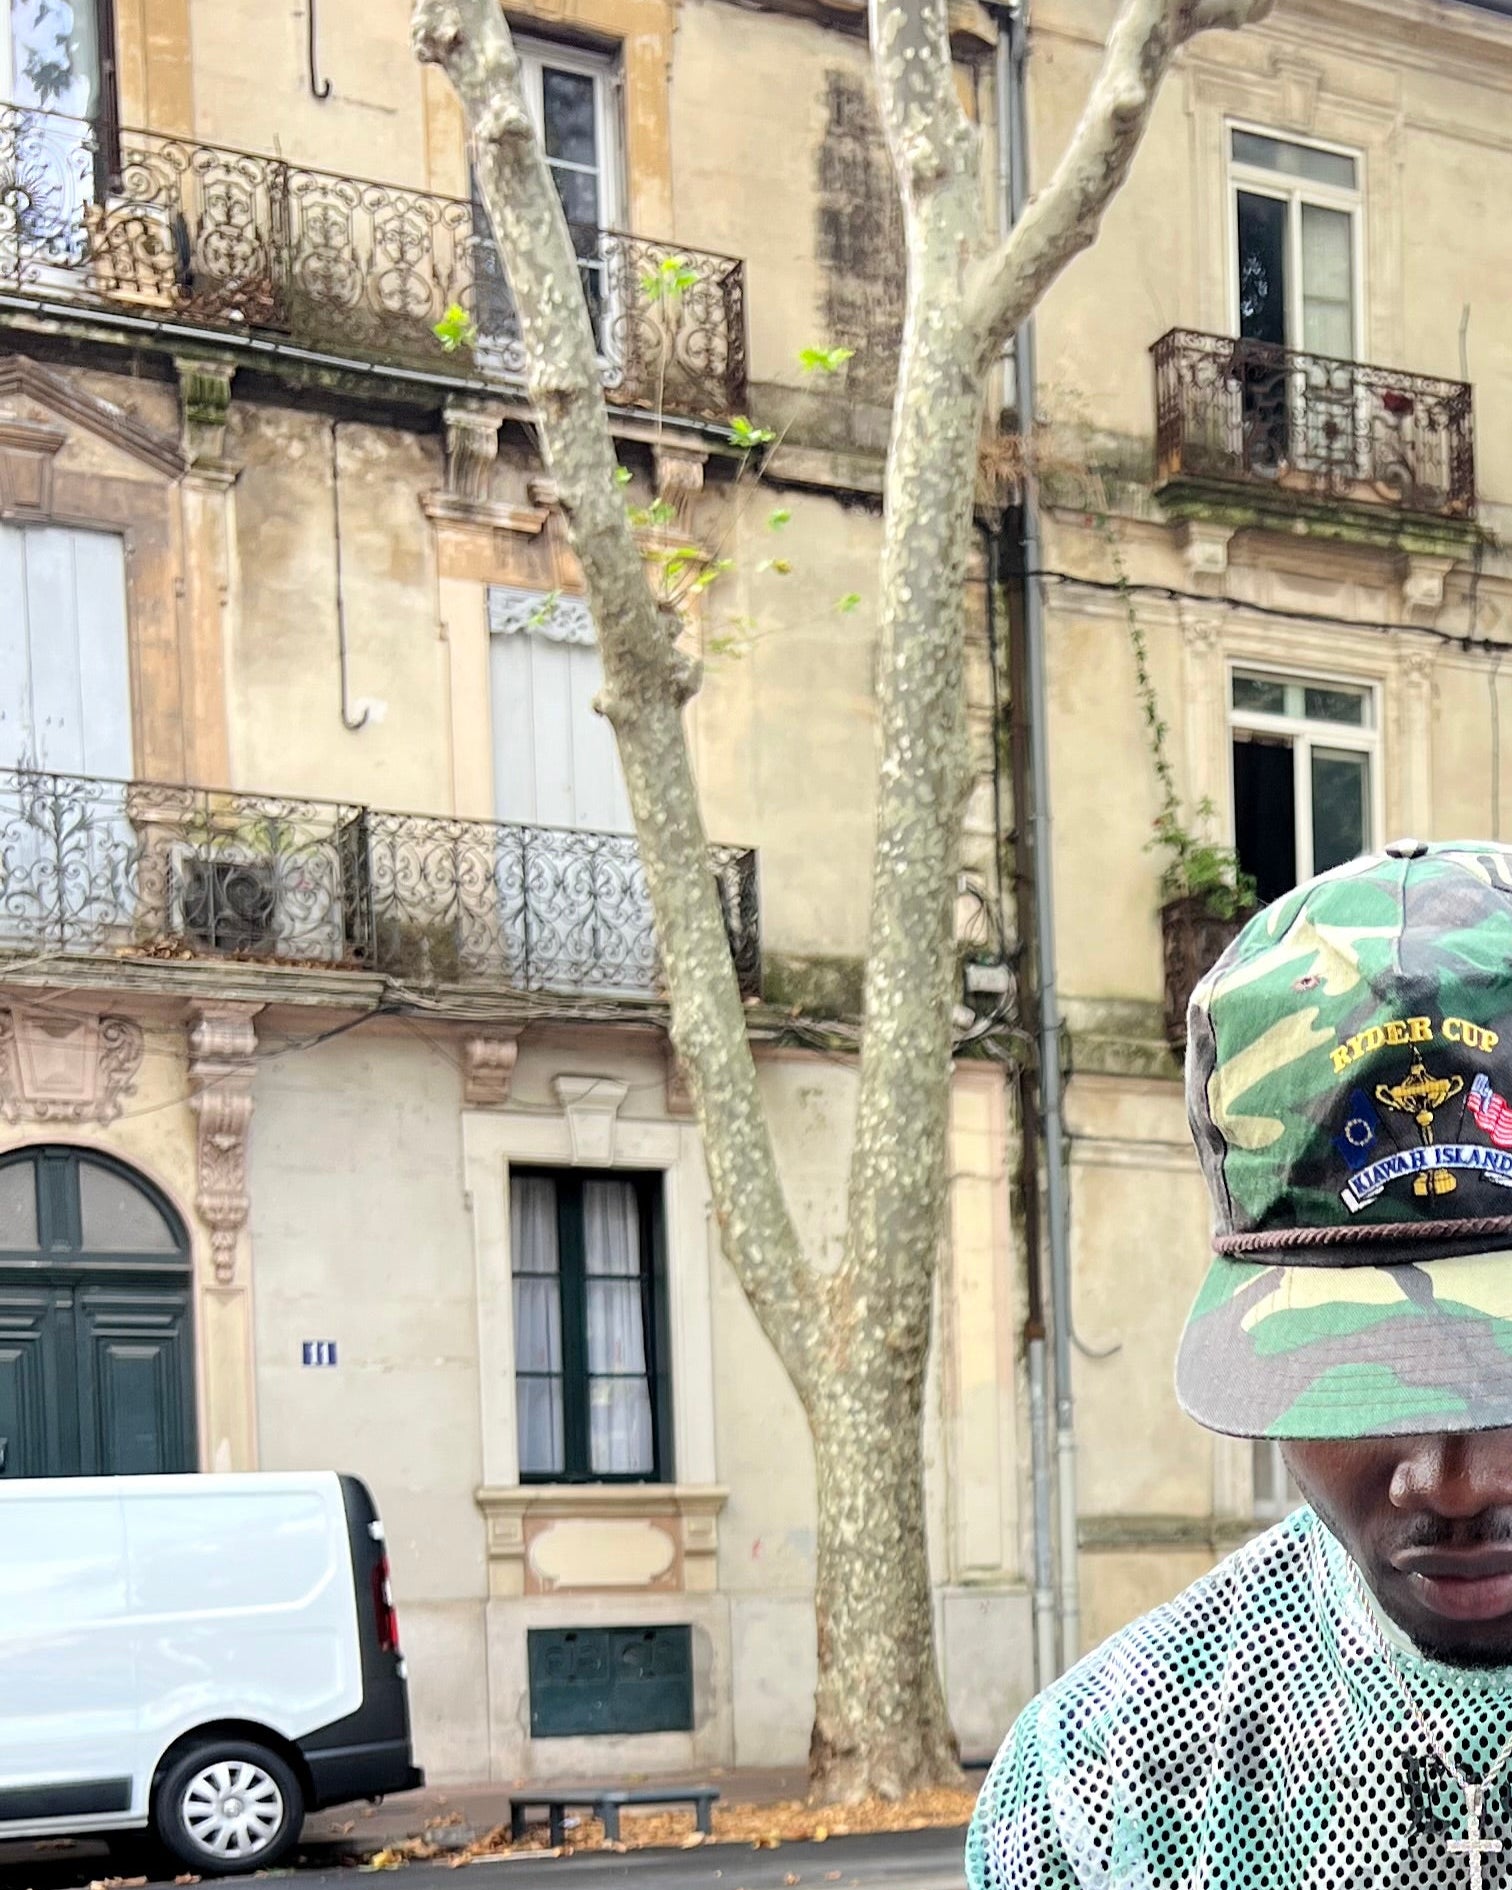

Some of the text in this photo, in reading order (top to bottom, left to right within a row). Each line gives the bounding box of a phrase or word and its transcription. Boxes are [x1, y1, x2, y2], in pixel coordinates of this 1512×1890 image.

[1329, 1016, 1499, 1074] RYDER CUP
[1351, 1147, 1426, 1194] KIAWAH
